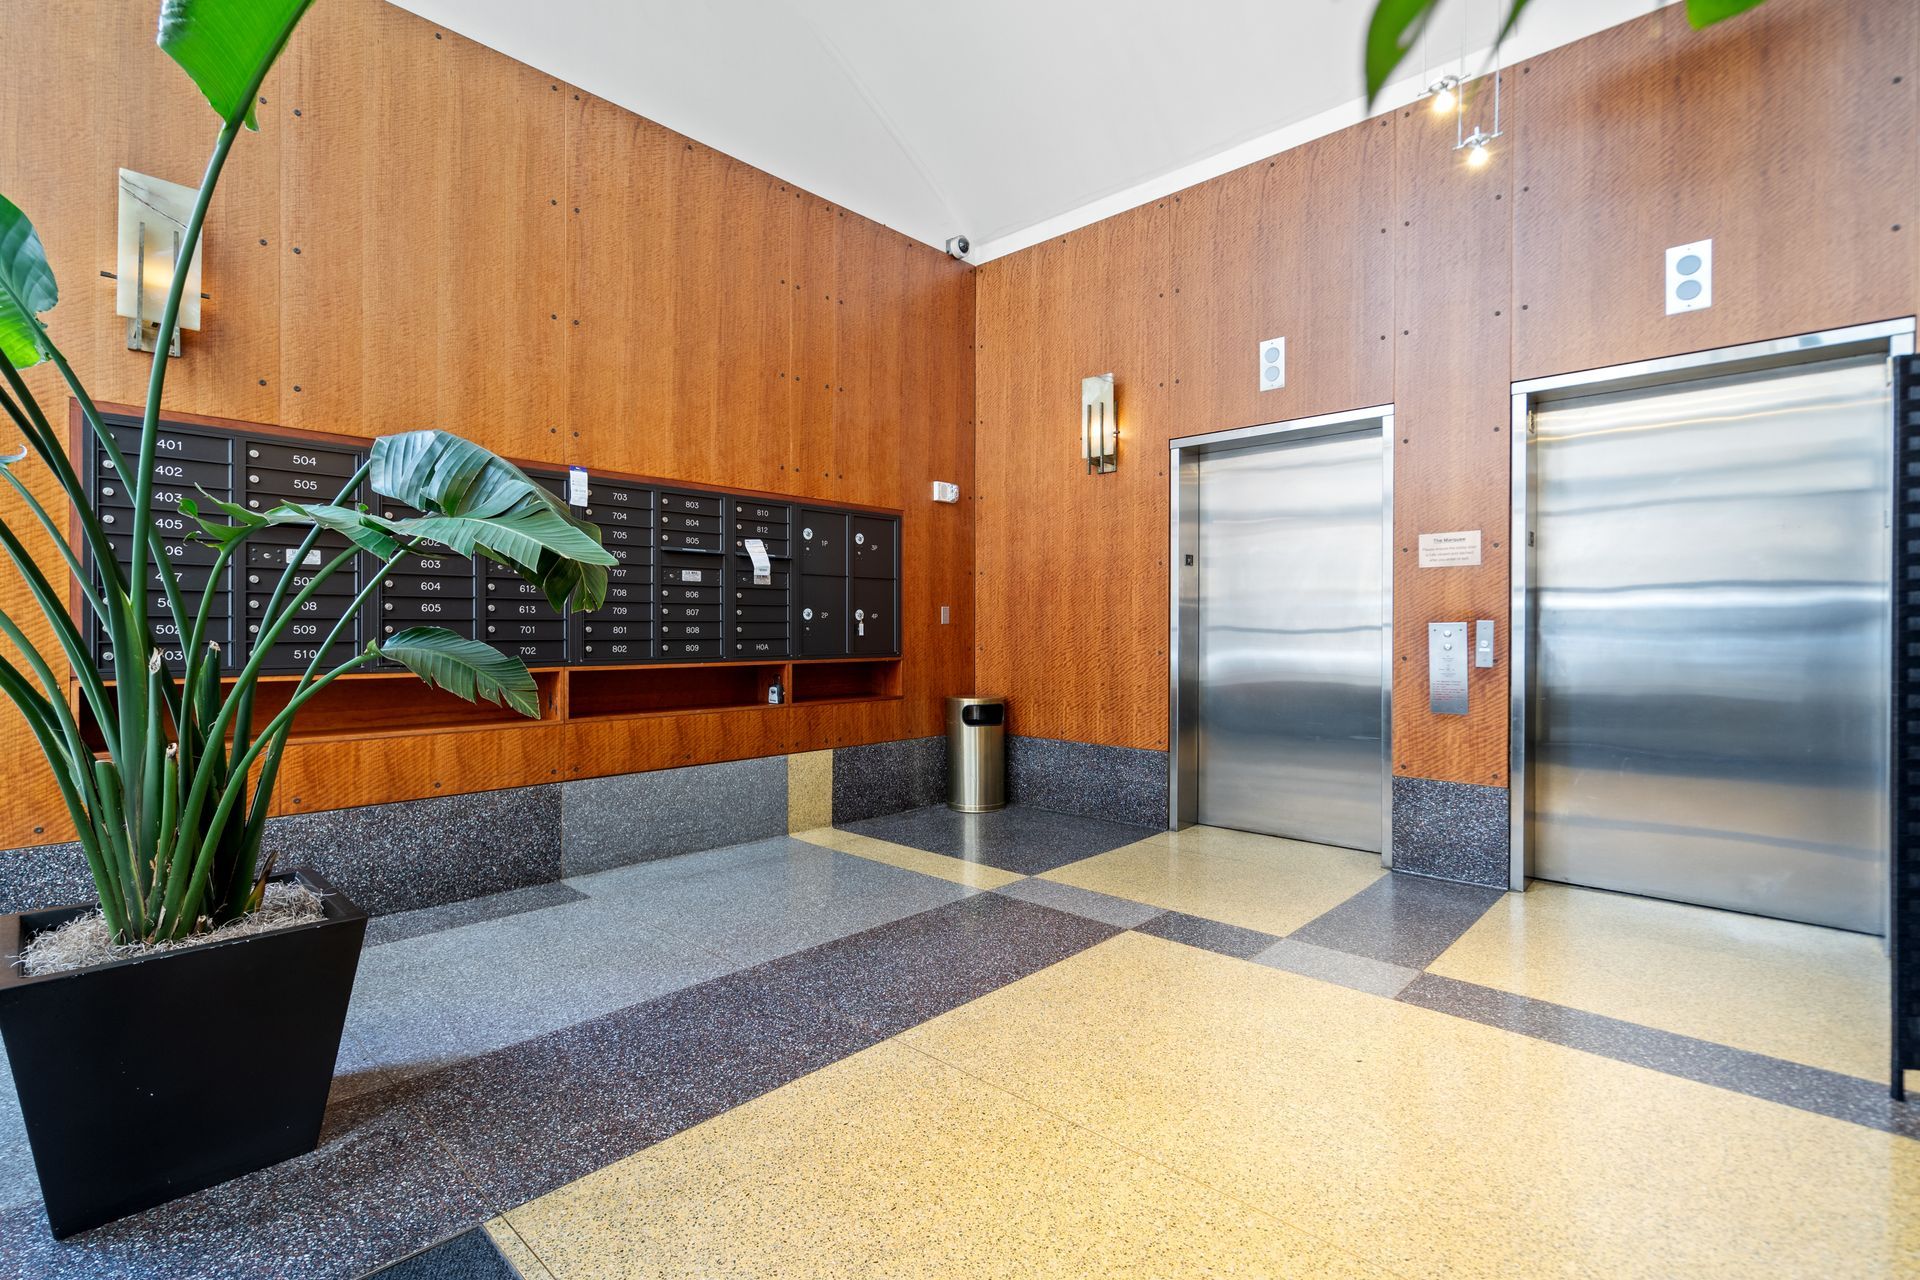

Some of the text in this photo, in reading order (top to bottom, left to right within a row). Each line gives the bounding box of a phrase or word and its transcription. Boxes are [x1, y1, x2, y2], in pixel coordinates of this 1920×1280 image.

[156, 439, 183, 451] 401
[292, 454, 317, 467] 504
[155, 465, 183, 477] 402
[293, 479, 318, 491] 505
[154, 492, 182, 503] 403
[612, 492, 628, 502] 703
[685, 501, 700, 510] 803
[612, 511, 628, 521] 704
[756, 509, 770, 517] 810
[155, 518, 183, 531] 405
[685, 518, 700, 527] 804
[756, 526, 769, 534] 812
[612, 531, 628, 540] 705
[685, 536, 700, 545] 805
[165, 545, 183, 556] 06
[611, 550, 627, 559] 706
[420, 559, 441, 569] 603
[155, 572, 183, 582] 47
[611, 569, 627, 577] 707
[293, 576, 315, 586] 50
[420, 581, 441, 591] 604
[519, 584, 537, 593] 612
[611, 588, 628, 597] 708
[685, 590, 700, 599] 806
[301, 601, 317, 611] 08
[421, 603, 442, 613] 605
[518, 605, 537, 614] 613
[611, 607, 628, 615] 709
[685, 608, 700, 616] 807
[292, 625, 317, 635] 509
[519, 625, 536, 634] 701
[612, 626, 627, 634] 801
[685, 626, 700, 634] 808
[519, 646, 537, 655] 702
[611, 644, 628, 653] 802
[685, 644, 700, 652] 809
[164, 650, 184, 661] 03
[293, 649, 317, 660] 510
